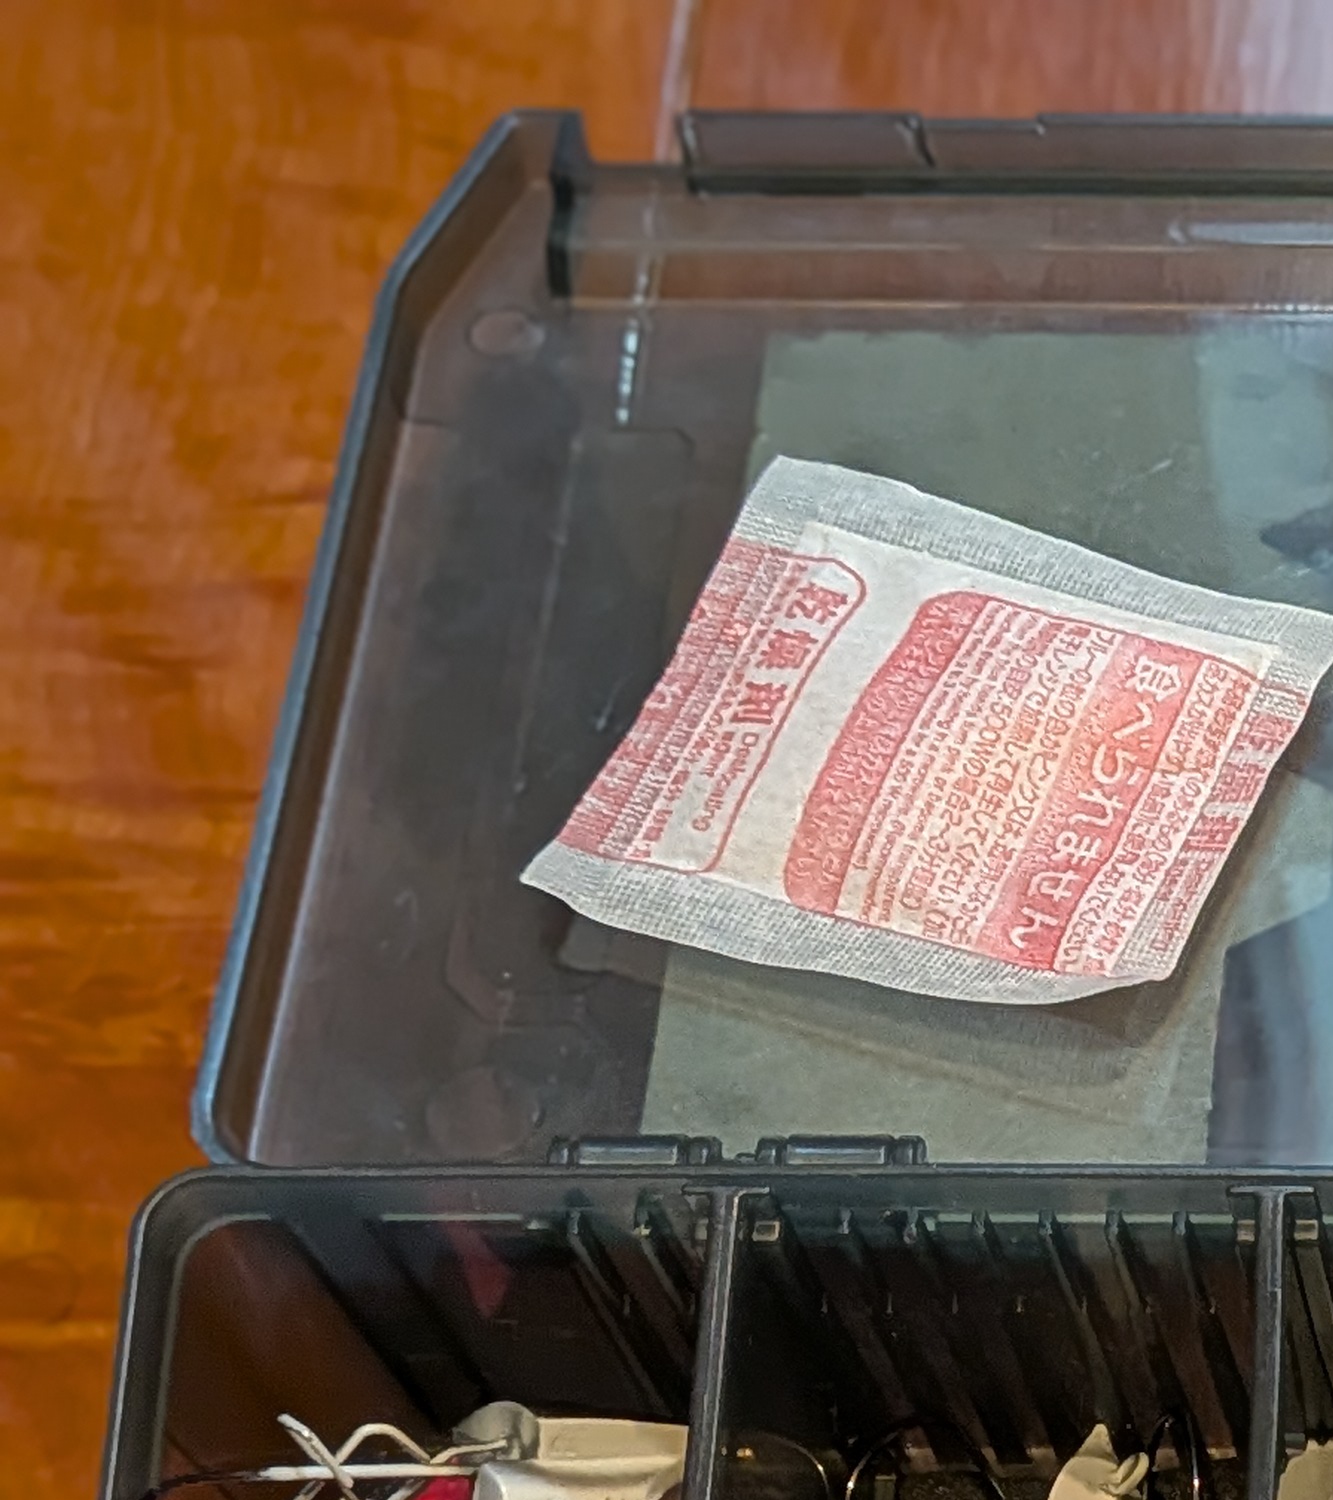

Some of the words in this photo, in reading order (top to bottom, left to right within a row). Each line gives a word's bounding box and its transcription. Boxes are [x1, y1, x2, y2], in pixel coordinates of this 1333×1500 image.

[723, 581, 853, 731] 乾燥剤
[1002, 654, 1189, 953] 食べられません
